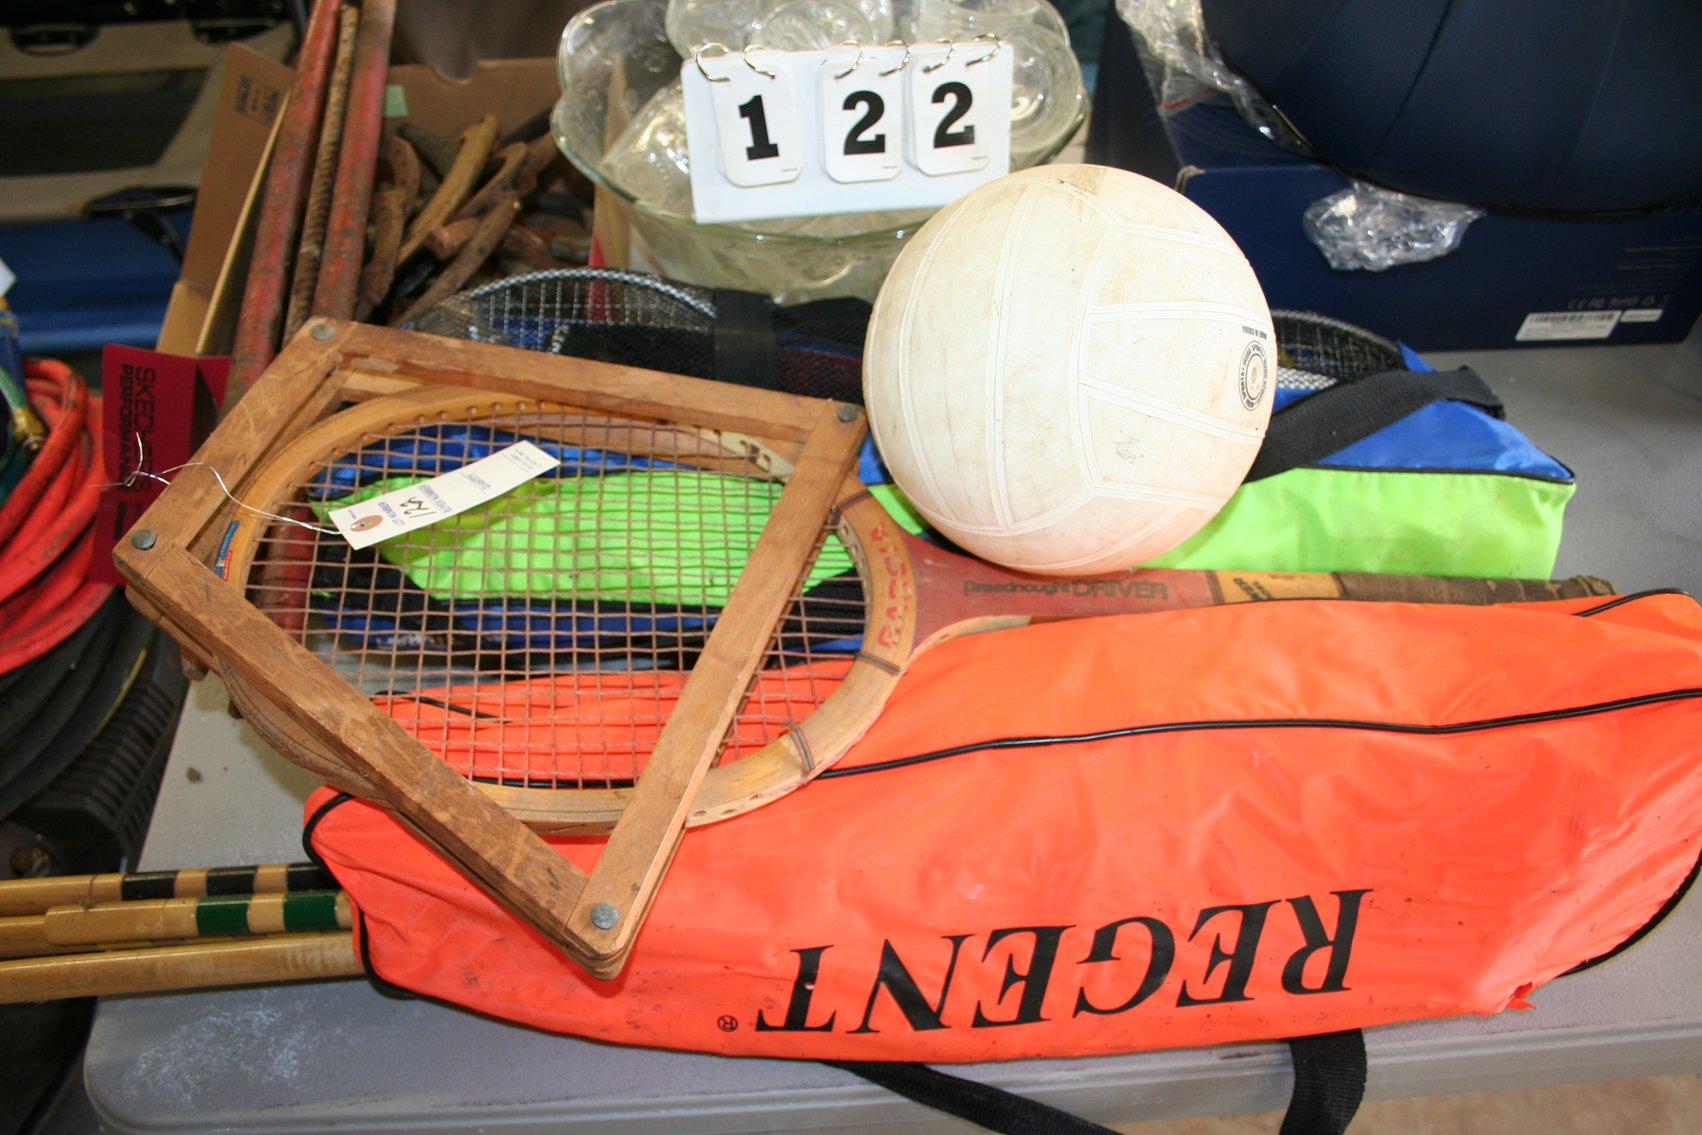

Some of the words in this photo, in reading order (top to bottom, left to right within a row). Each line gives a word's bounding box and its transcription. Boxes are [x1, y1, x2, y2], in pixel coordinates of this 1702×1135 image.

[134, 366, 156, 492] SKECHERS
[378, 501, 397, 517] NUMBER
[400, 496, 436, 518] 122
[1072, 579, 1169, 601] DRIVER
[755, 889, 1375, 1035] REGENT
